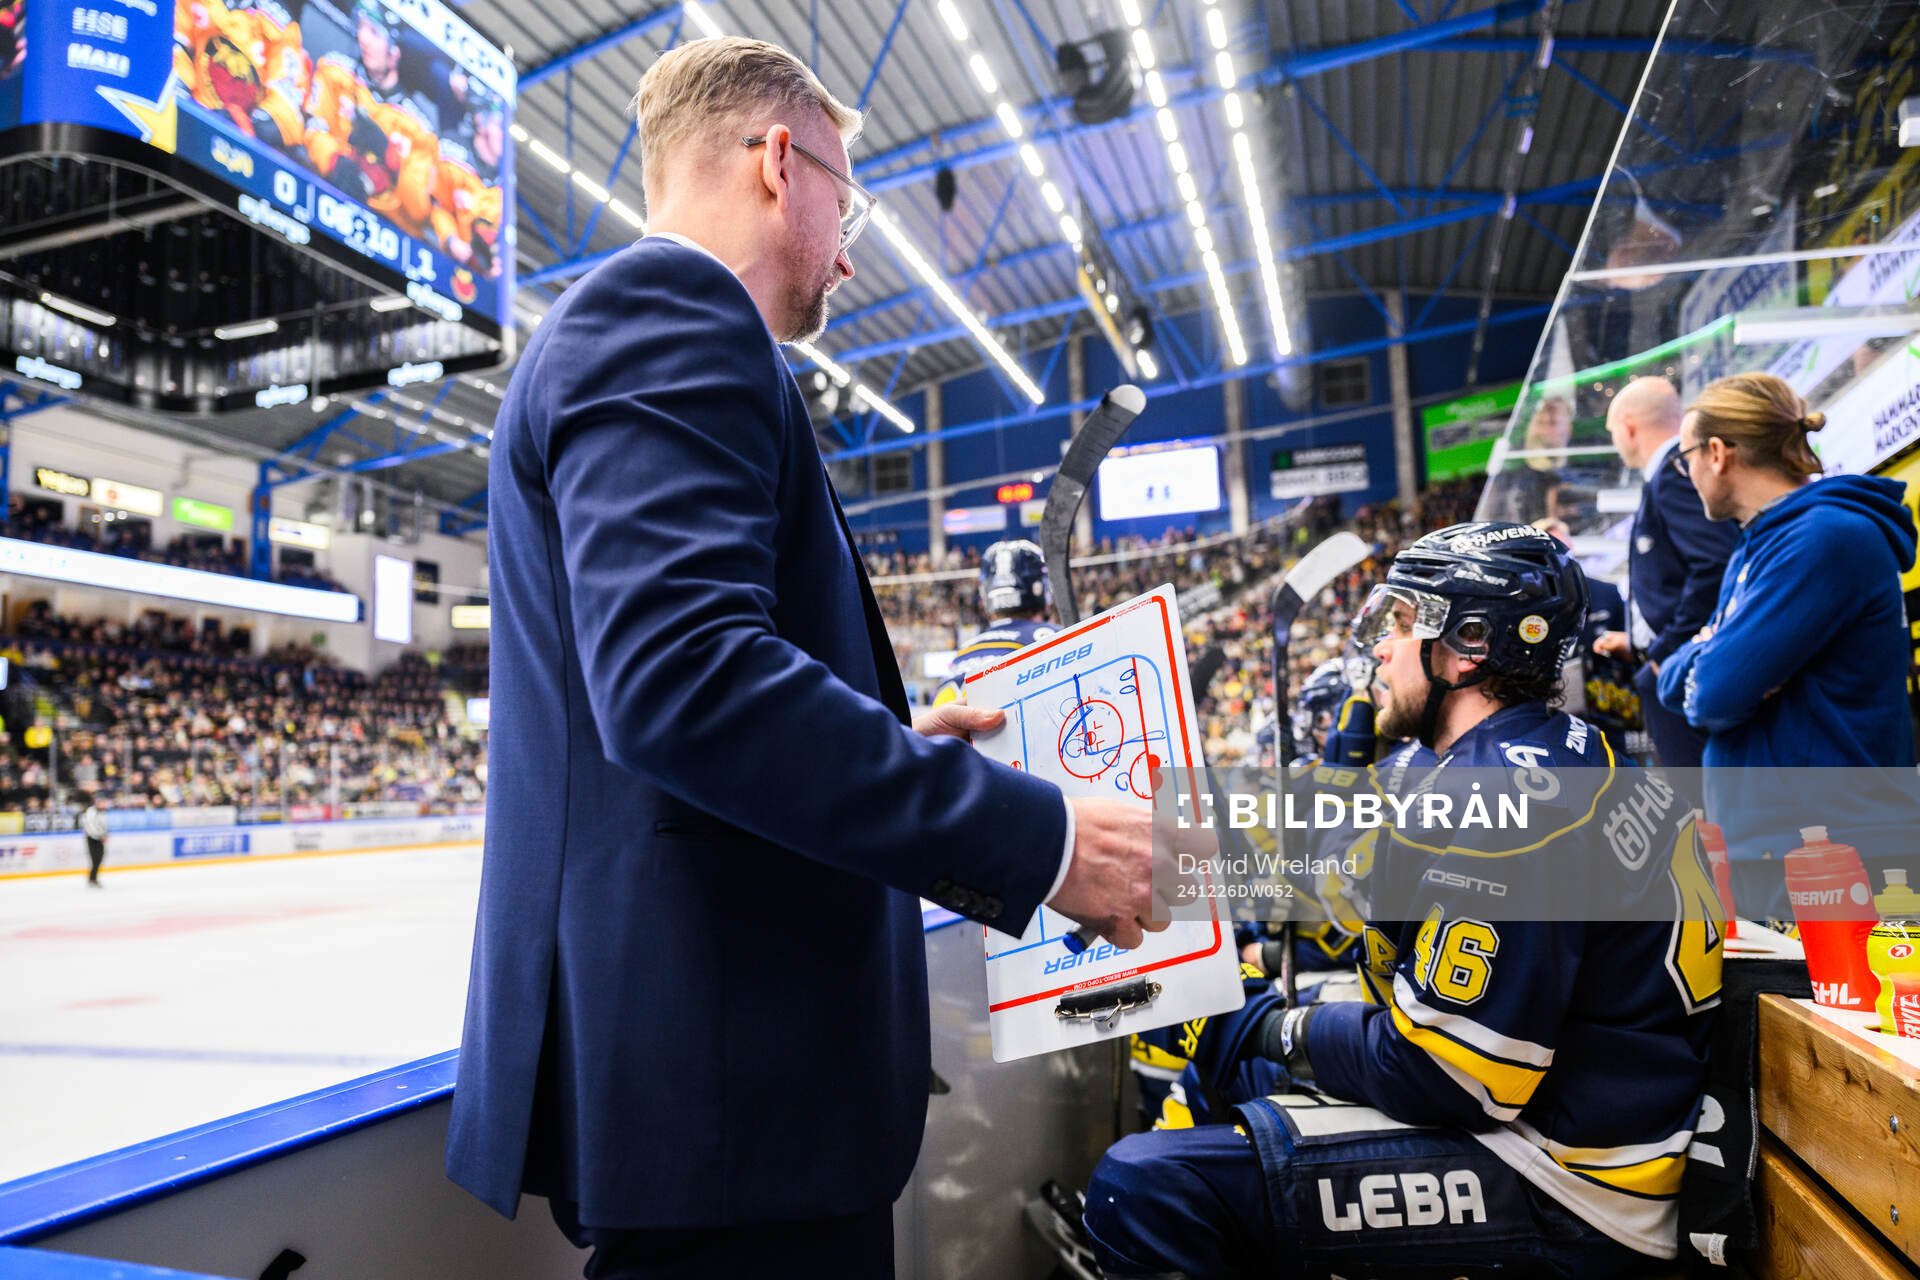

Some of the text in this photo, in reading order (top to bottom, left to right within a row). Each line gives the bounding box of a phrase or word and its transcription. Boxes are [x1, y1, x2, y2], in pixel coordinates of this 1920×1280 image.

[1016, 642, 1093, 686] BAUER
[1500, 742, 1560, 801] GÅ
[1413, 902, 1501, 1006] 46
[1318, 1169, 1488, 1232] LEBA
